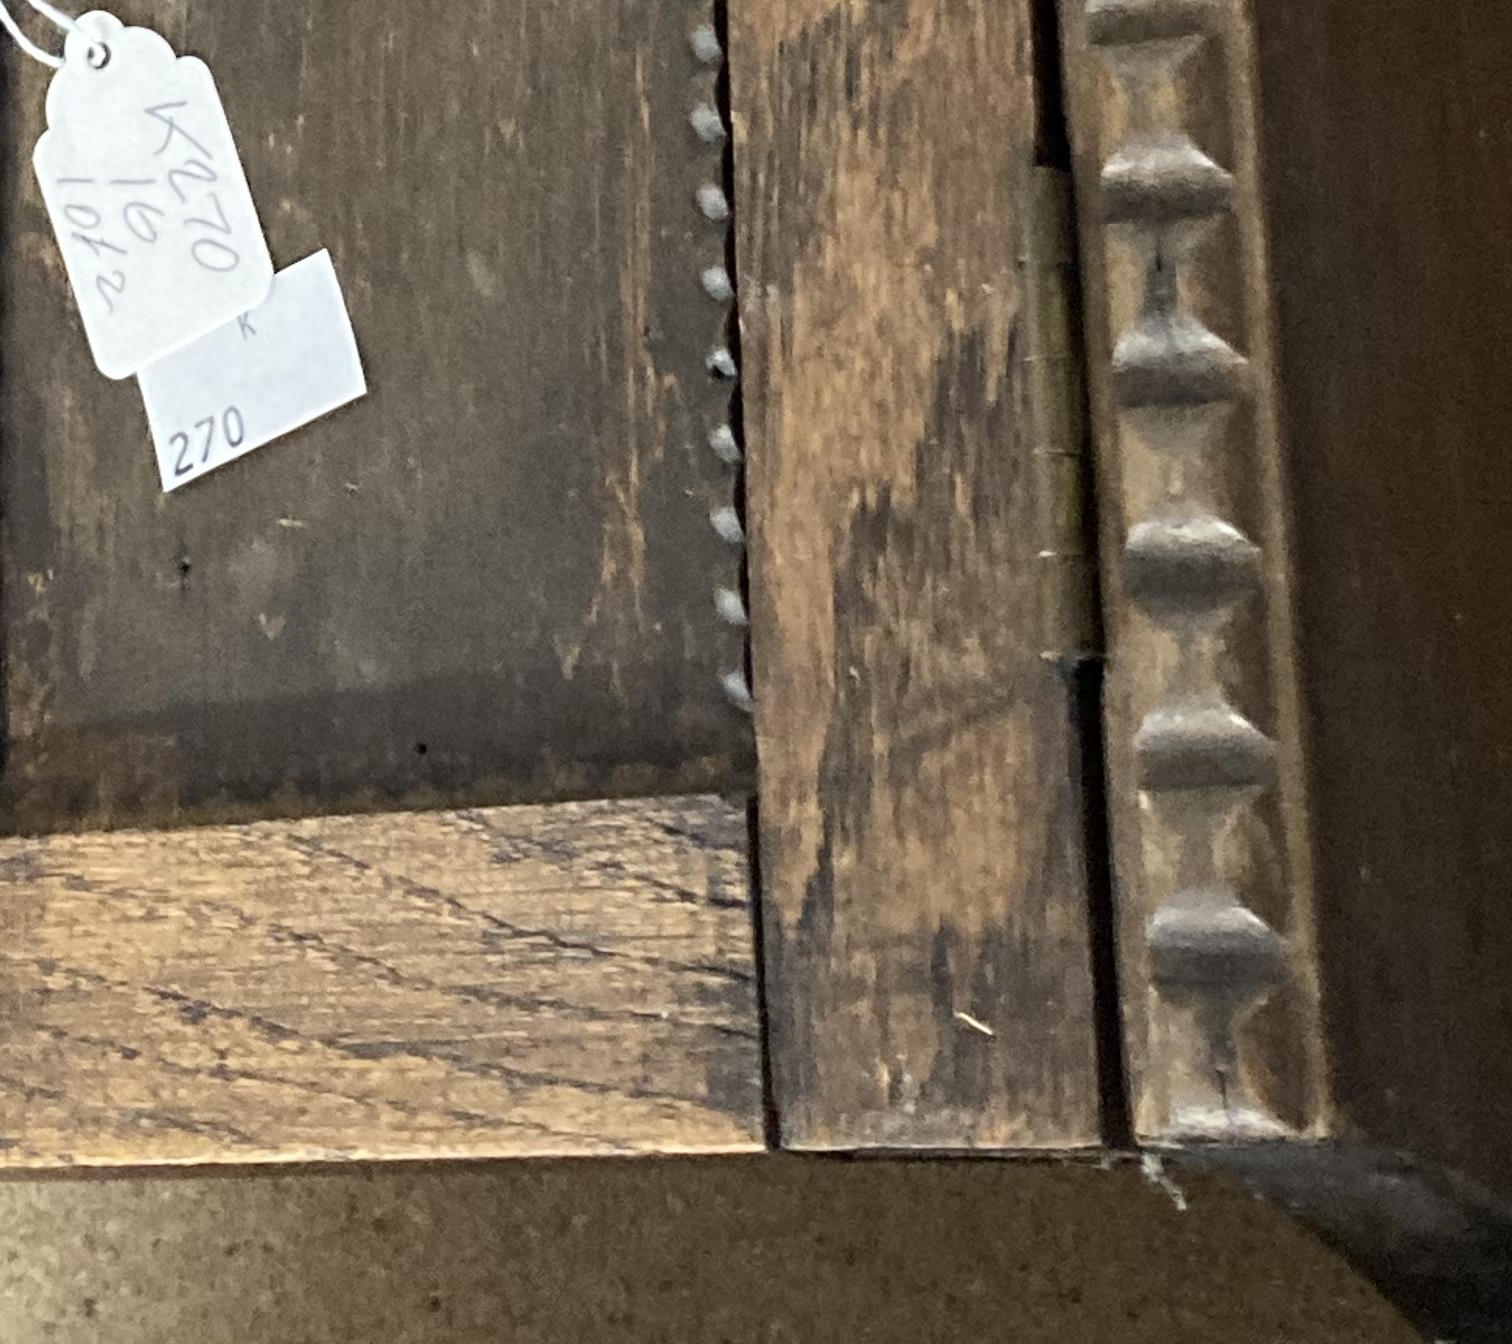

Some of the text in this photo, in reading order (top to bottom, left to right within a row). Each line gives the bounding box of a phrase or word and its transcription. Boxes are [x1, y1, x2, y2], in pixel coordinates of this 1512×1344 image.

[143, 99, 240, 273] K270
[95, 268, 126, 315] 2
[168, 405, 244, 477] 270
